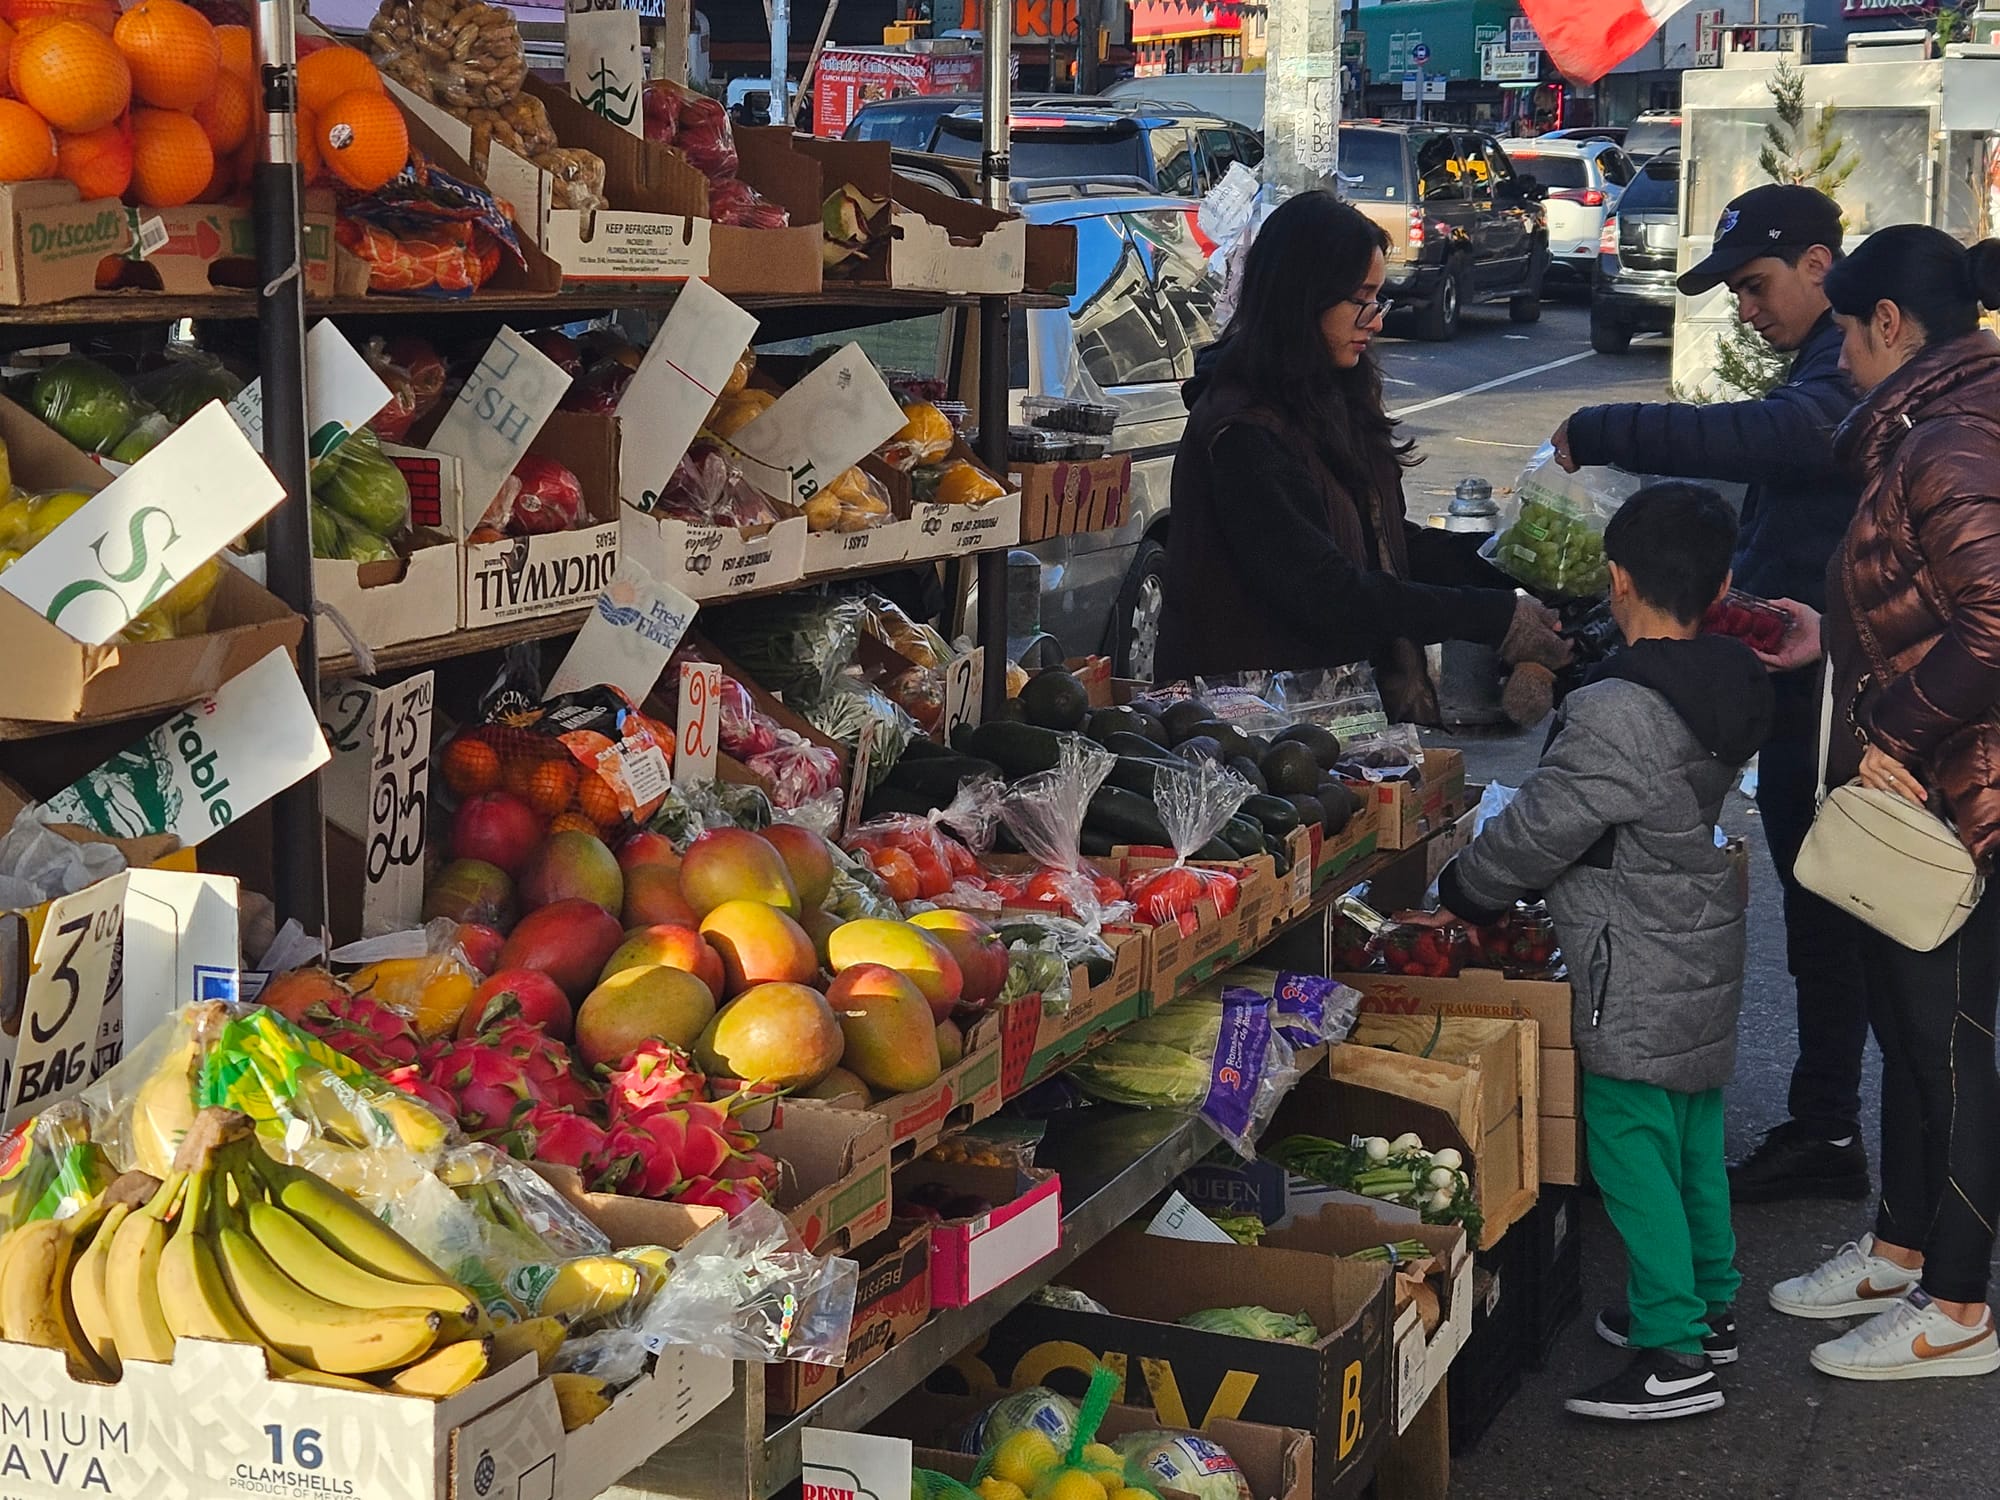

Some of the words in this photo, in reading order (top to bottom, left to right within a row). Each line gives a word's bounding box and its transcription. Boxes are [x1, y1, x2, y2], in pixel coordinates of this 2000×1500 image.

[1697, 54, 1714, 66] KFC
[29, 210, 120, 255] Driscoll's
[605, 223, 623, 235] KEEP
[625, 224, 673, 236] REFRIGERATED
[963, 520, 971, 532] OF
[596, 531, 617, 549] PEARS
[849, 534, 869, 550] CLASS
[961, 535, 982, 546] CLASS
[735, 557, 744, 570] OF
[474, 550, 616, 611] DUCKWALL
[734, 572, 755, 586] CLASS
[14, 1041, 86, 1108] BAG
[2, 1403, 129, 1454] MIUM
[263, 1423, 324, 1471] 16
[0, 1443, 112, 1494] AVA
[229, 1477, 289, 1497] PRODUCT
[292, 1486, 311, 1500] OF
[235, 1463, 354, 1496] CLAMSHELLS
